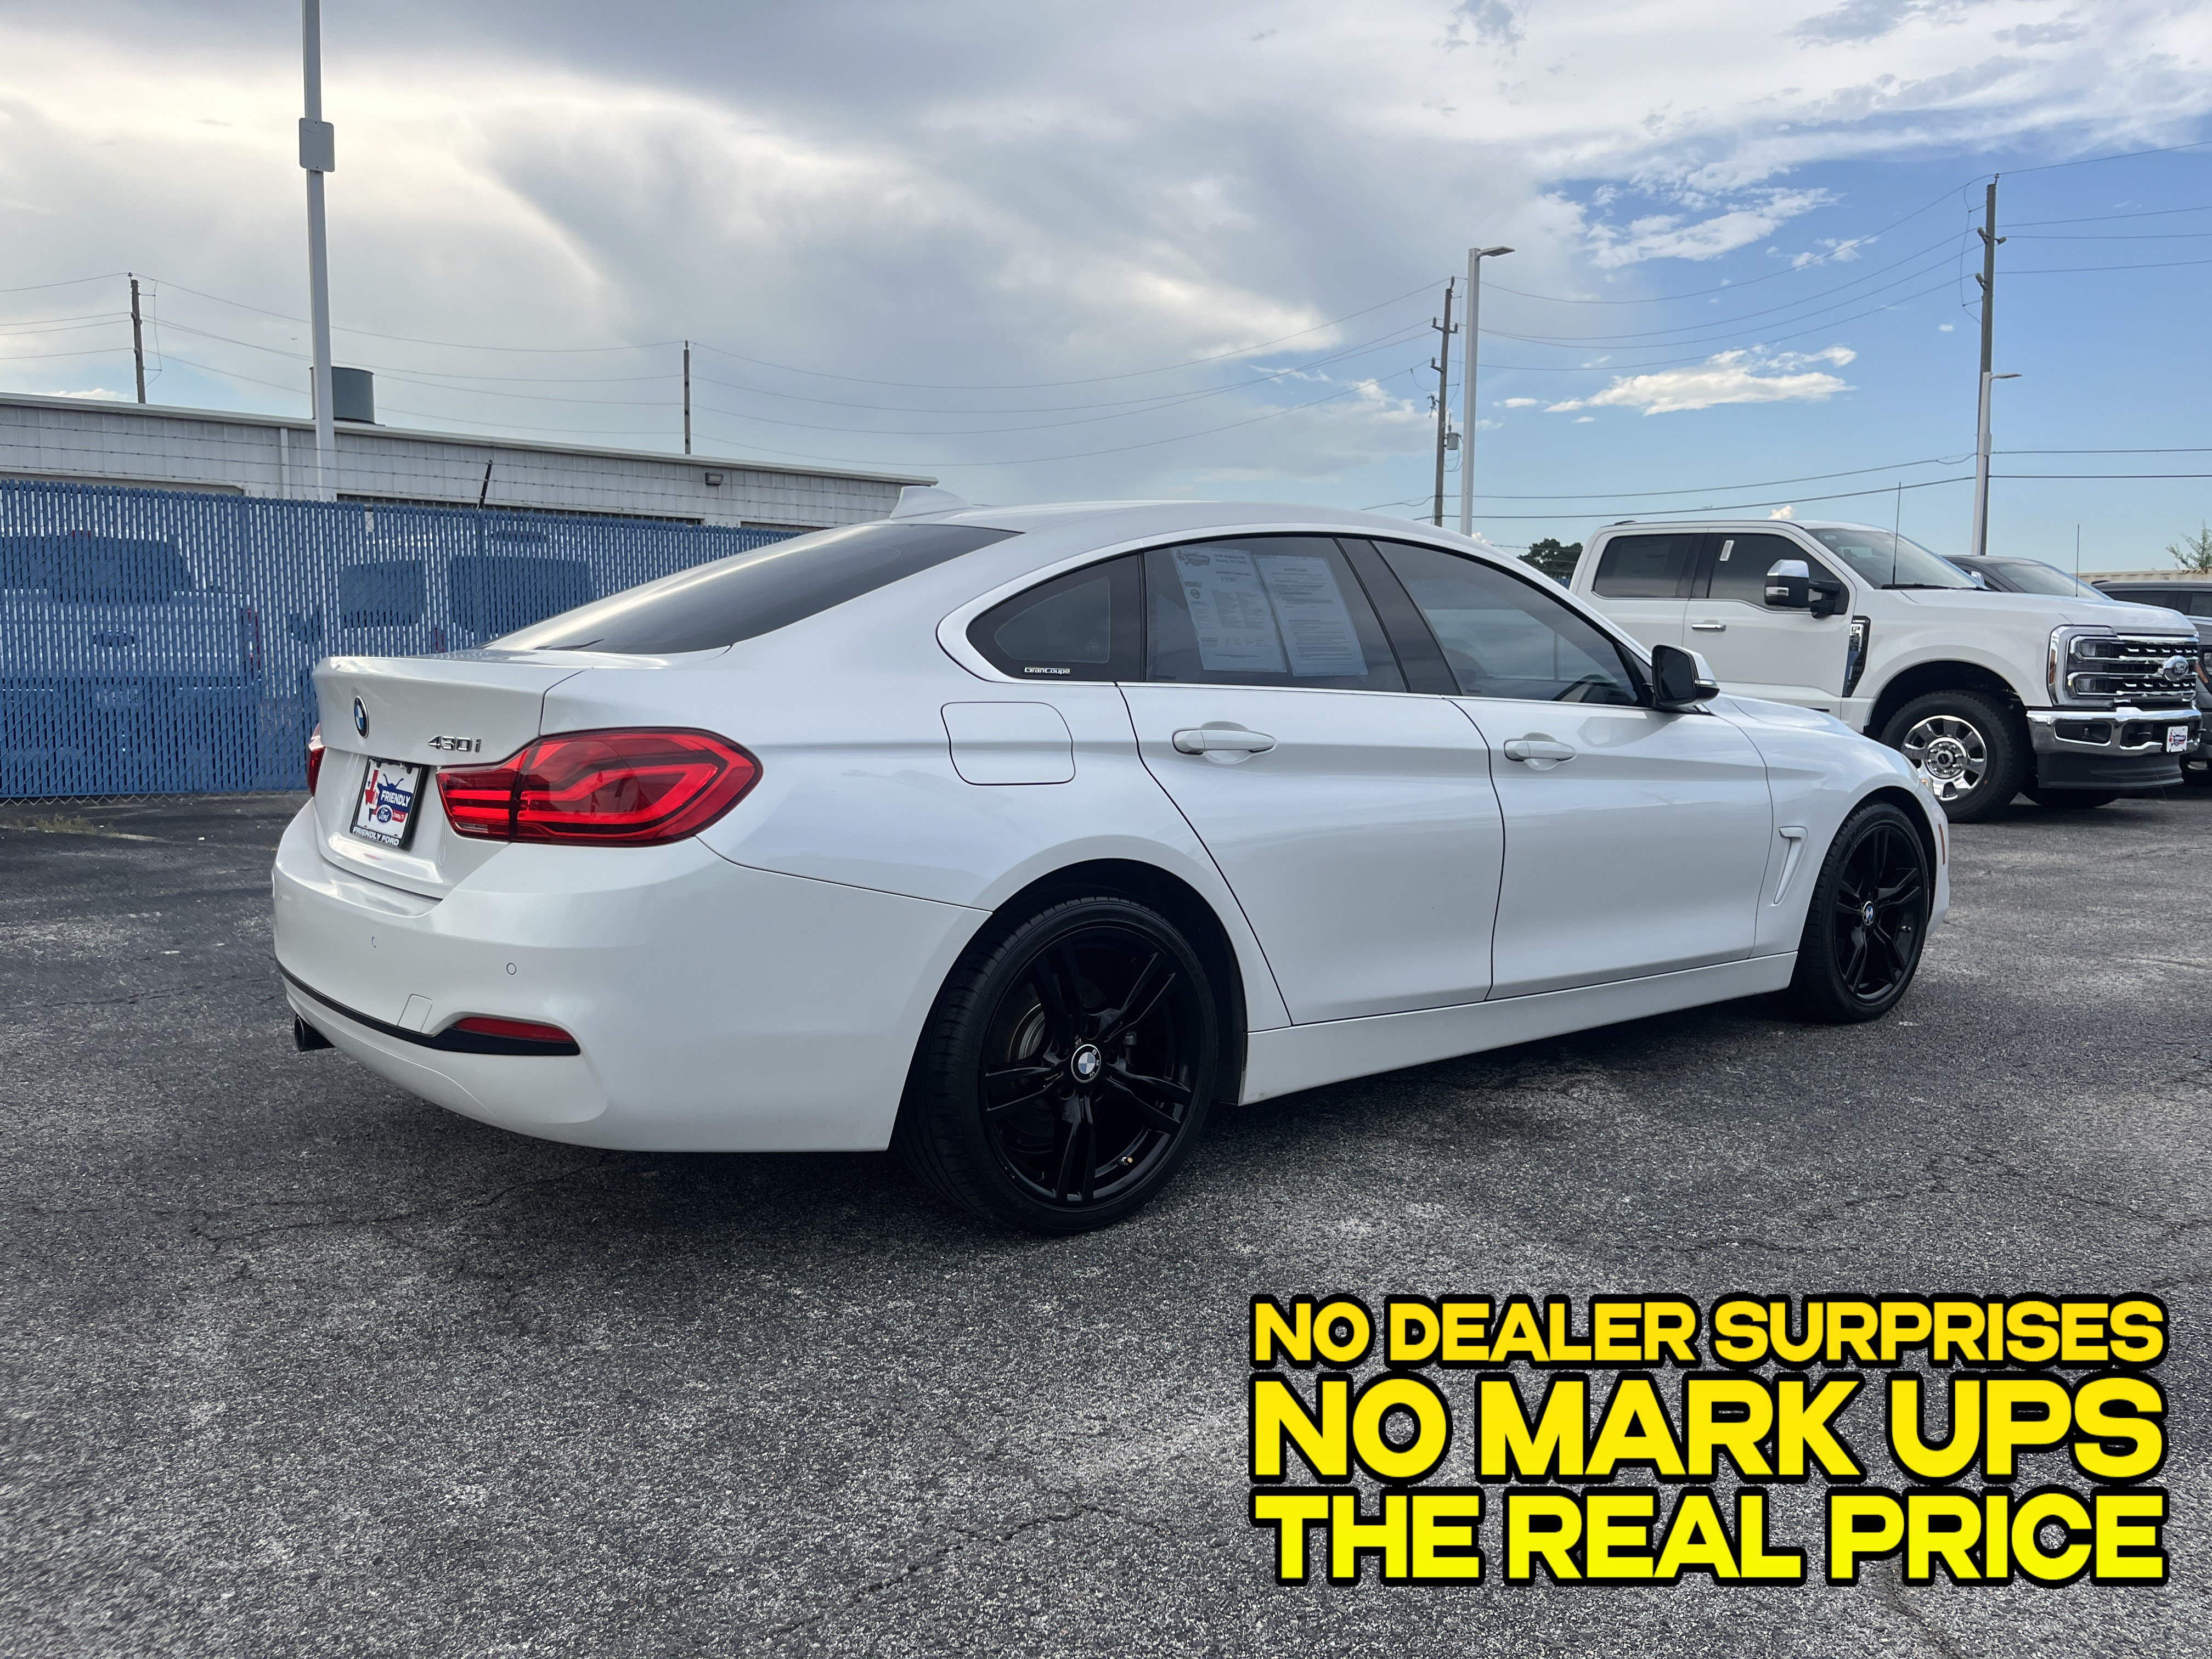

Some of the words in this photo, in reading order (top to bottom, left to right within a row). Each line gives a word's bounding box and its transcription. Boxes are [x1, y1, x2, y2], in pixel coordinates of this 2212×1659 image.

[428, 736, 482, 753] 430i
[381, 790, 410, 808] FRIENDLY
[378, 808, 390, 822] Ford
[352, 826, 381, 841] FRIENDLY
[381, 834, 399, 847] FORD
